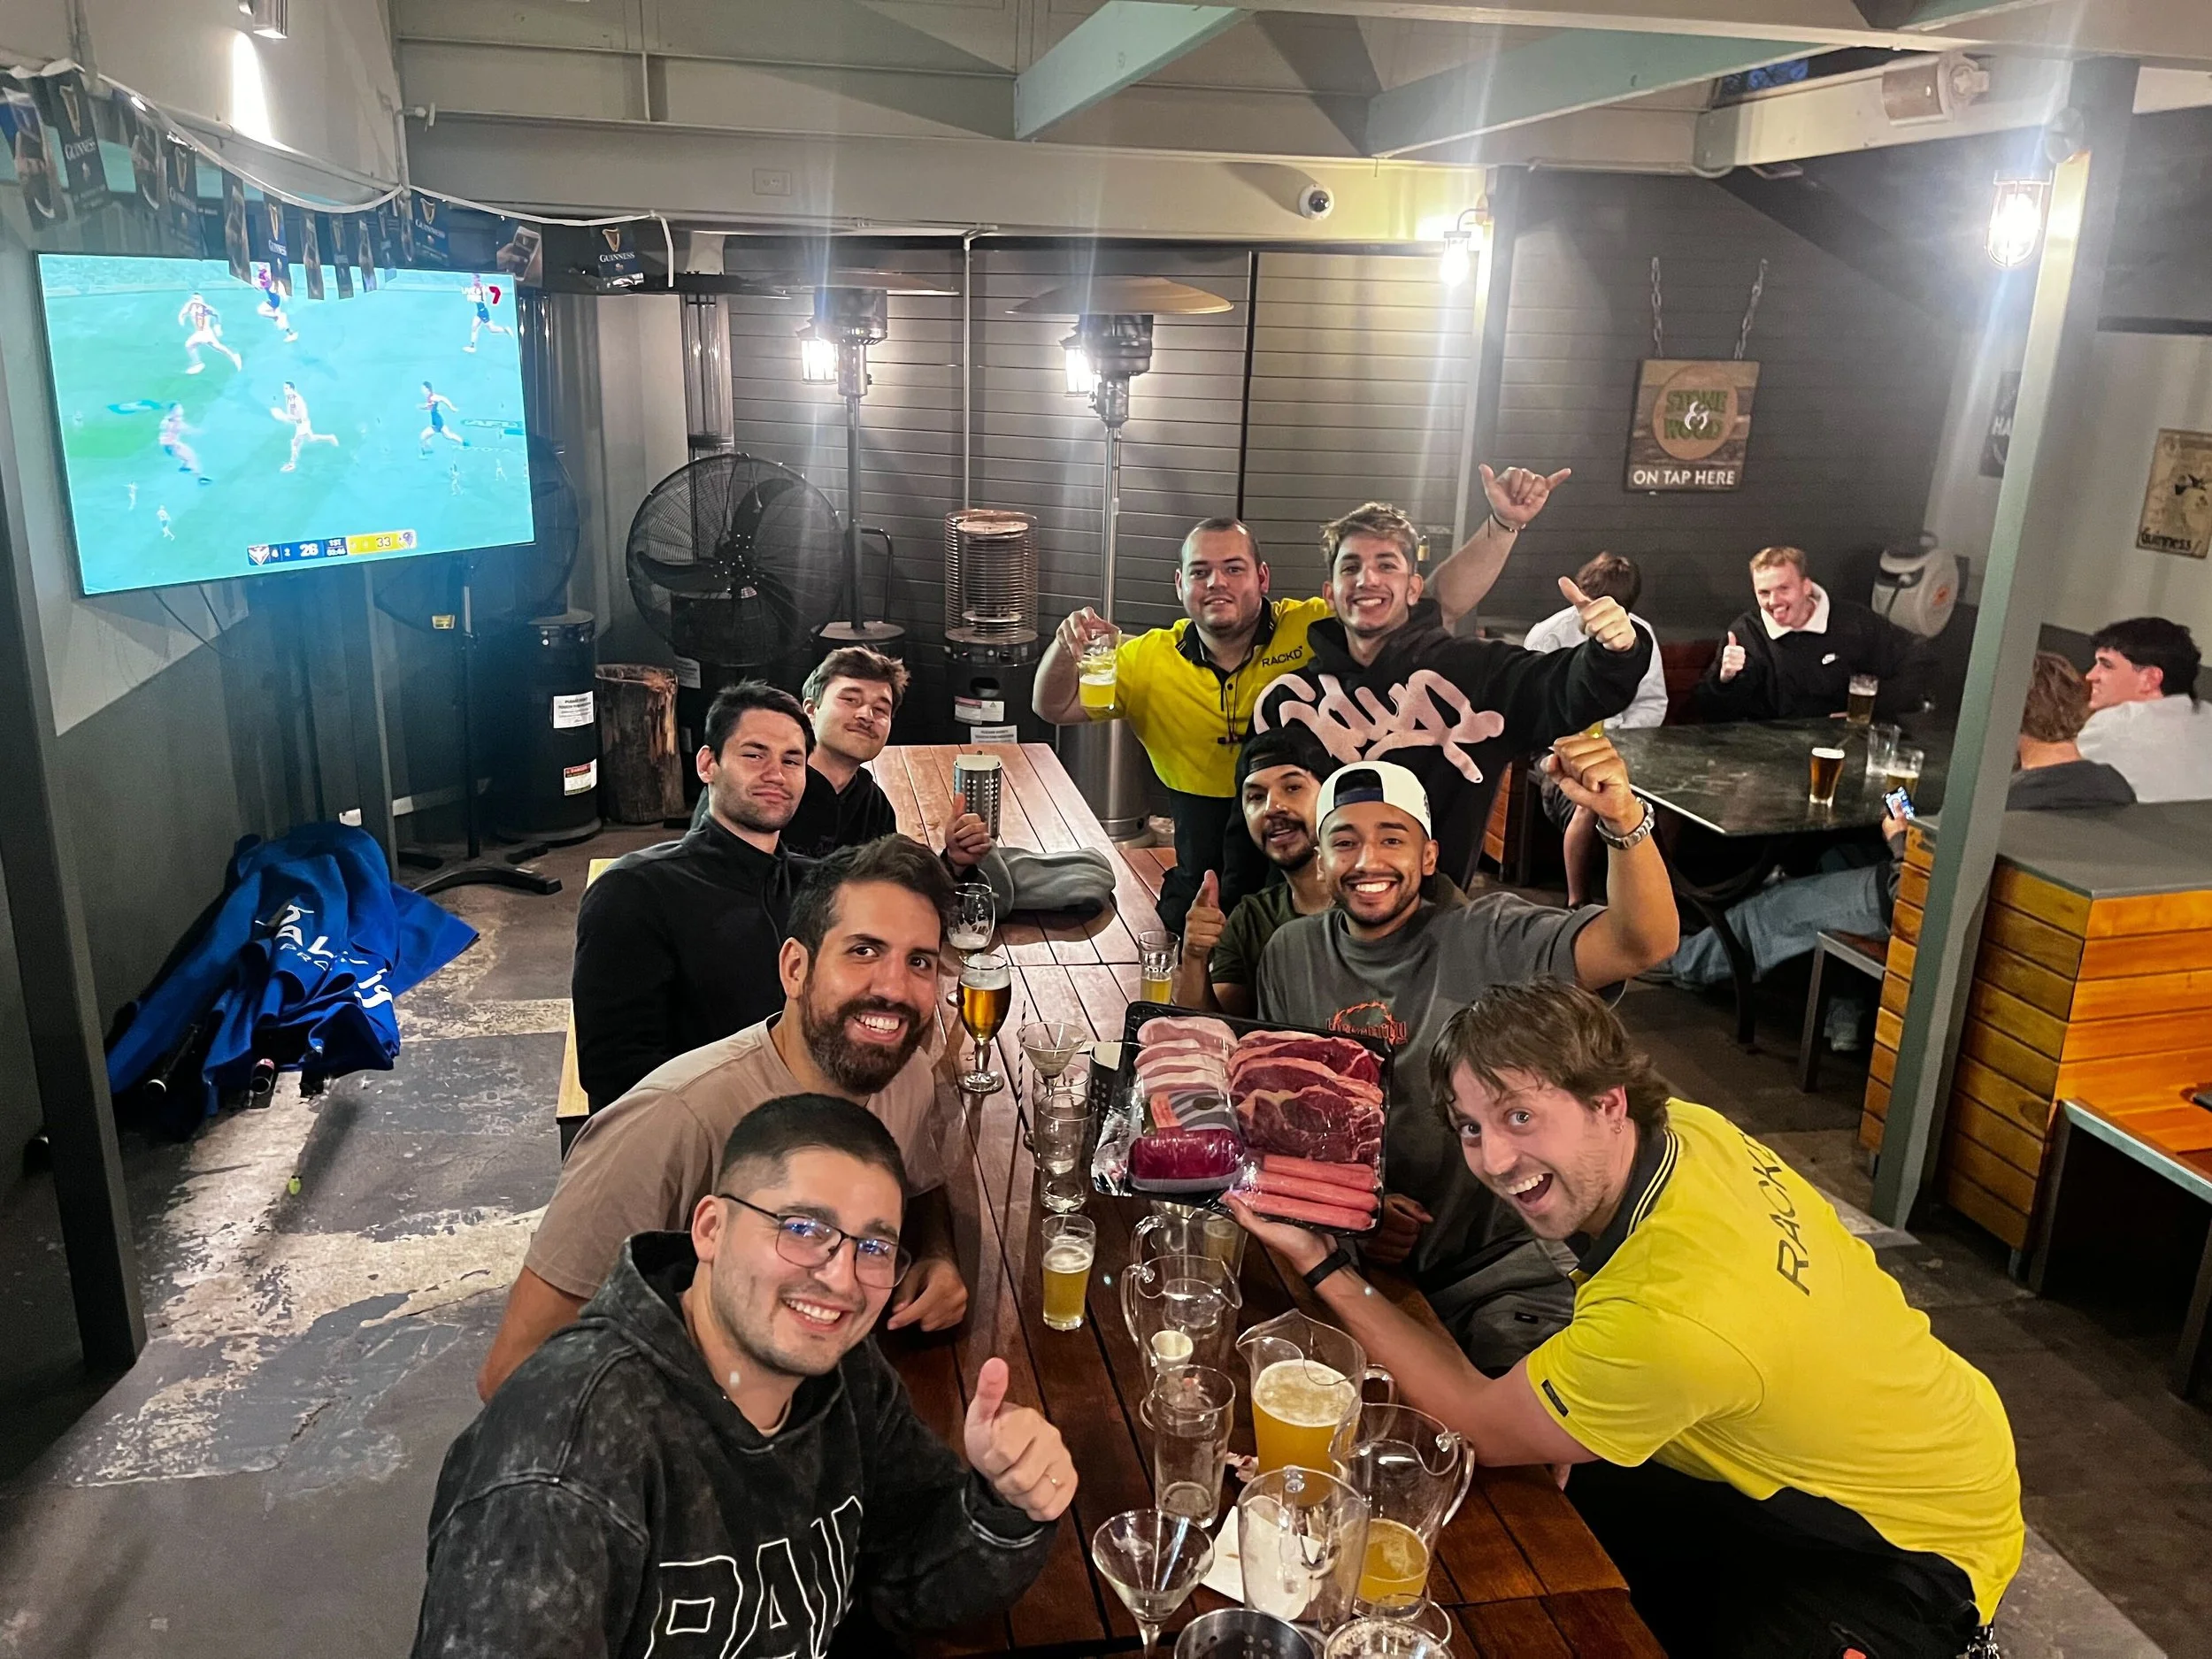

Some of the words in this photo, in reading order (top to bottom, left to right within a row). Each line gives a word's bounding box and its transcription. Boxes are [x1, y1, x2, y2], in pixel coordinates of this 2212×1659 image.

[599, 251, 635, 263] GUINNESS
[488, 286, 501, 304] 7
[1665, 389, 1728, 413] STONE
[1684, 400, 1710, 430] &
[1663, 418, 1723, 441] WOOD
[1632, 470, 1659, 486] ON
[1663, 470, 1692, 486] TAP
[1694, 470, 1736, 486] HERE
[299, 542, 319, 557] 26
[376, 537, 391, 548] 33
[1262, 646, 1303, 668] RACKD
